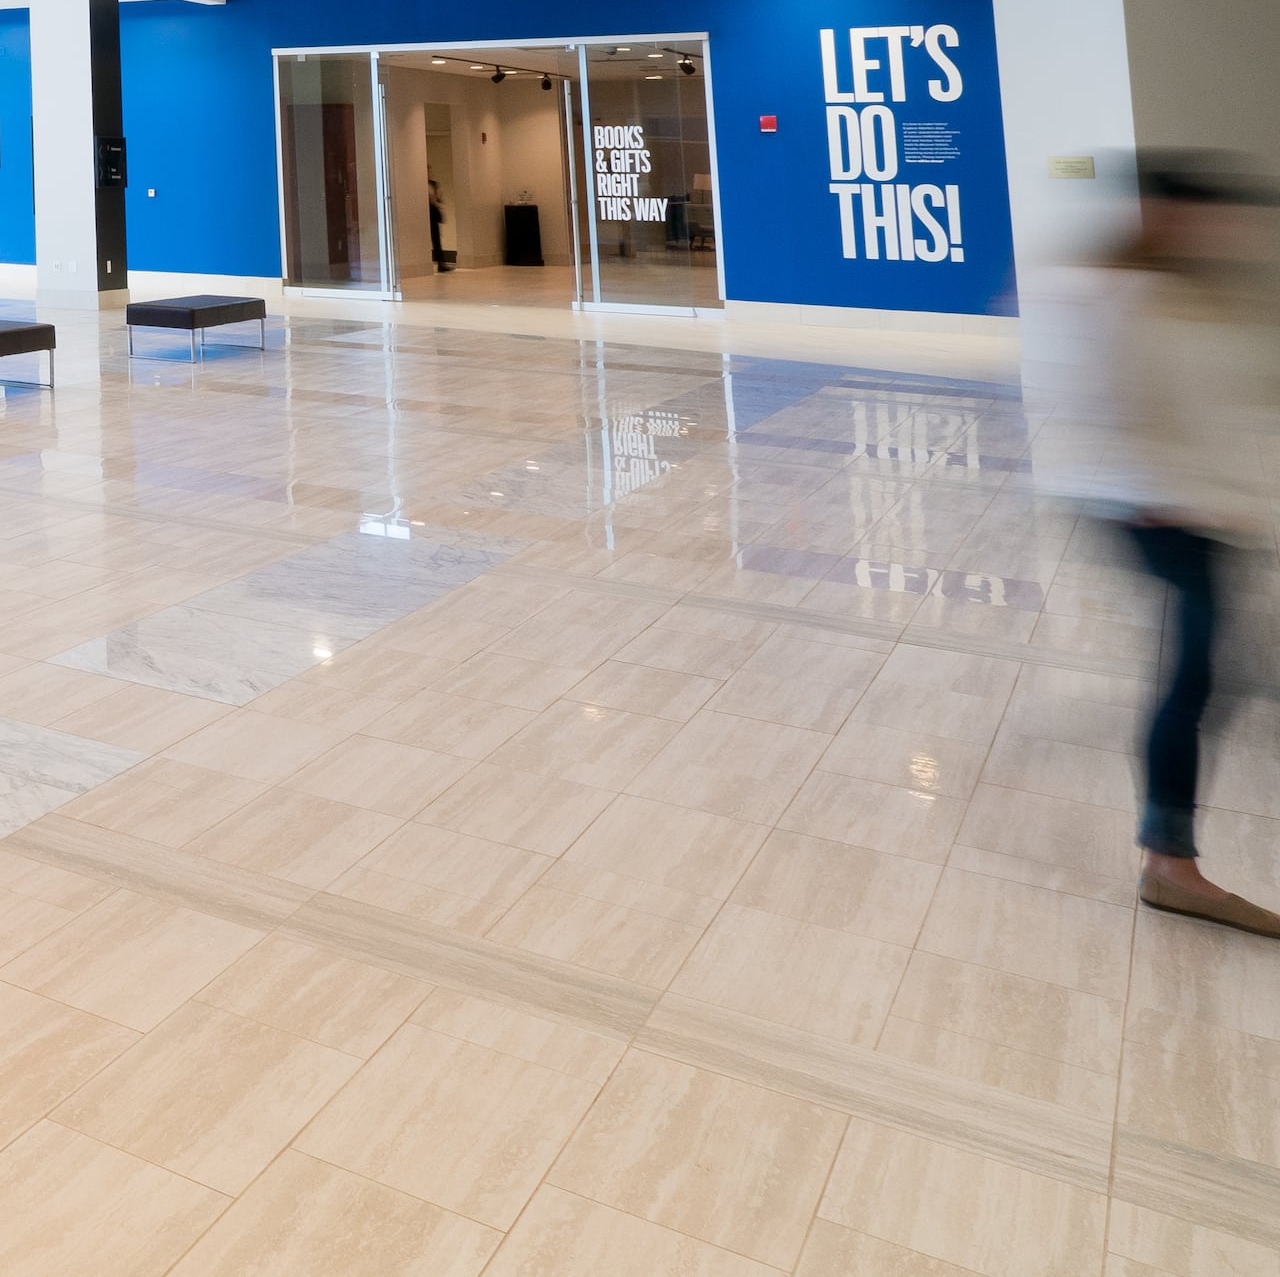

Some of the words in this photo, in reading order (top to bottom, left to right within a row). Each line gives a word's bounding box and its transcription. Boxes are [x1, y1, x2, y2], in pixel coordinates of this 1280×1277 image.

[819, 24, 964, 104] LET'S
[594, 126, 644, 149] BOOKS
[825, 104, 898, 182] DO
[595, 150, 608, 173] &
[610, 150, 652, 174] GIFTS
[596, 173, 640, 197] RIGHT
[597, 197, 632, 221] THIS
[632, 198, 668, 222] WAY
[828, 183, 965, 263] THIS!
